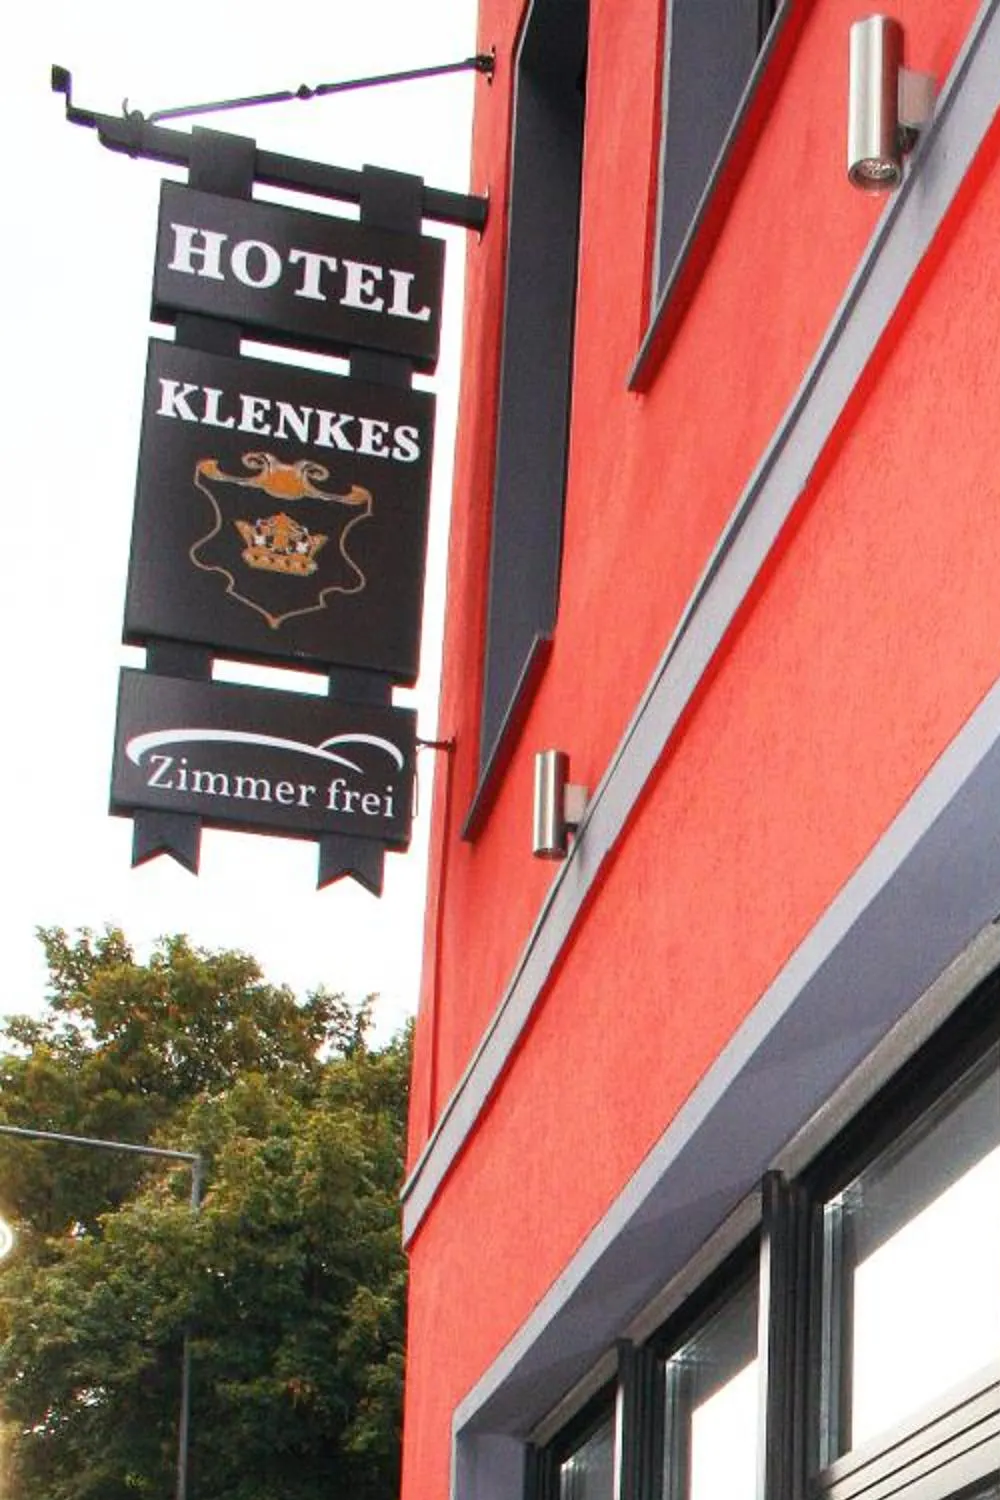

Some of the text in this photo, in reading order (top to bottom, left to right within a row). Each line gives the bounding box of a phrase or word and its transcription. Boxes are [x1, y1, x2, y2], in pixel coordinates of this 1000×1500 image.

[168, 223, 431, 321] HOTEL
[156, 378, 421, 462] KLENKES
[147, 754, 395, 818] Zimmer frei
